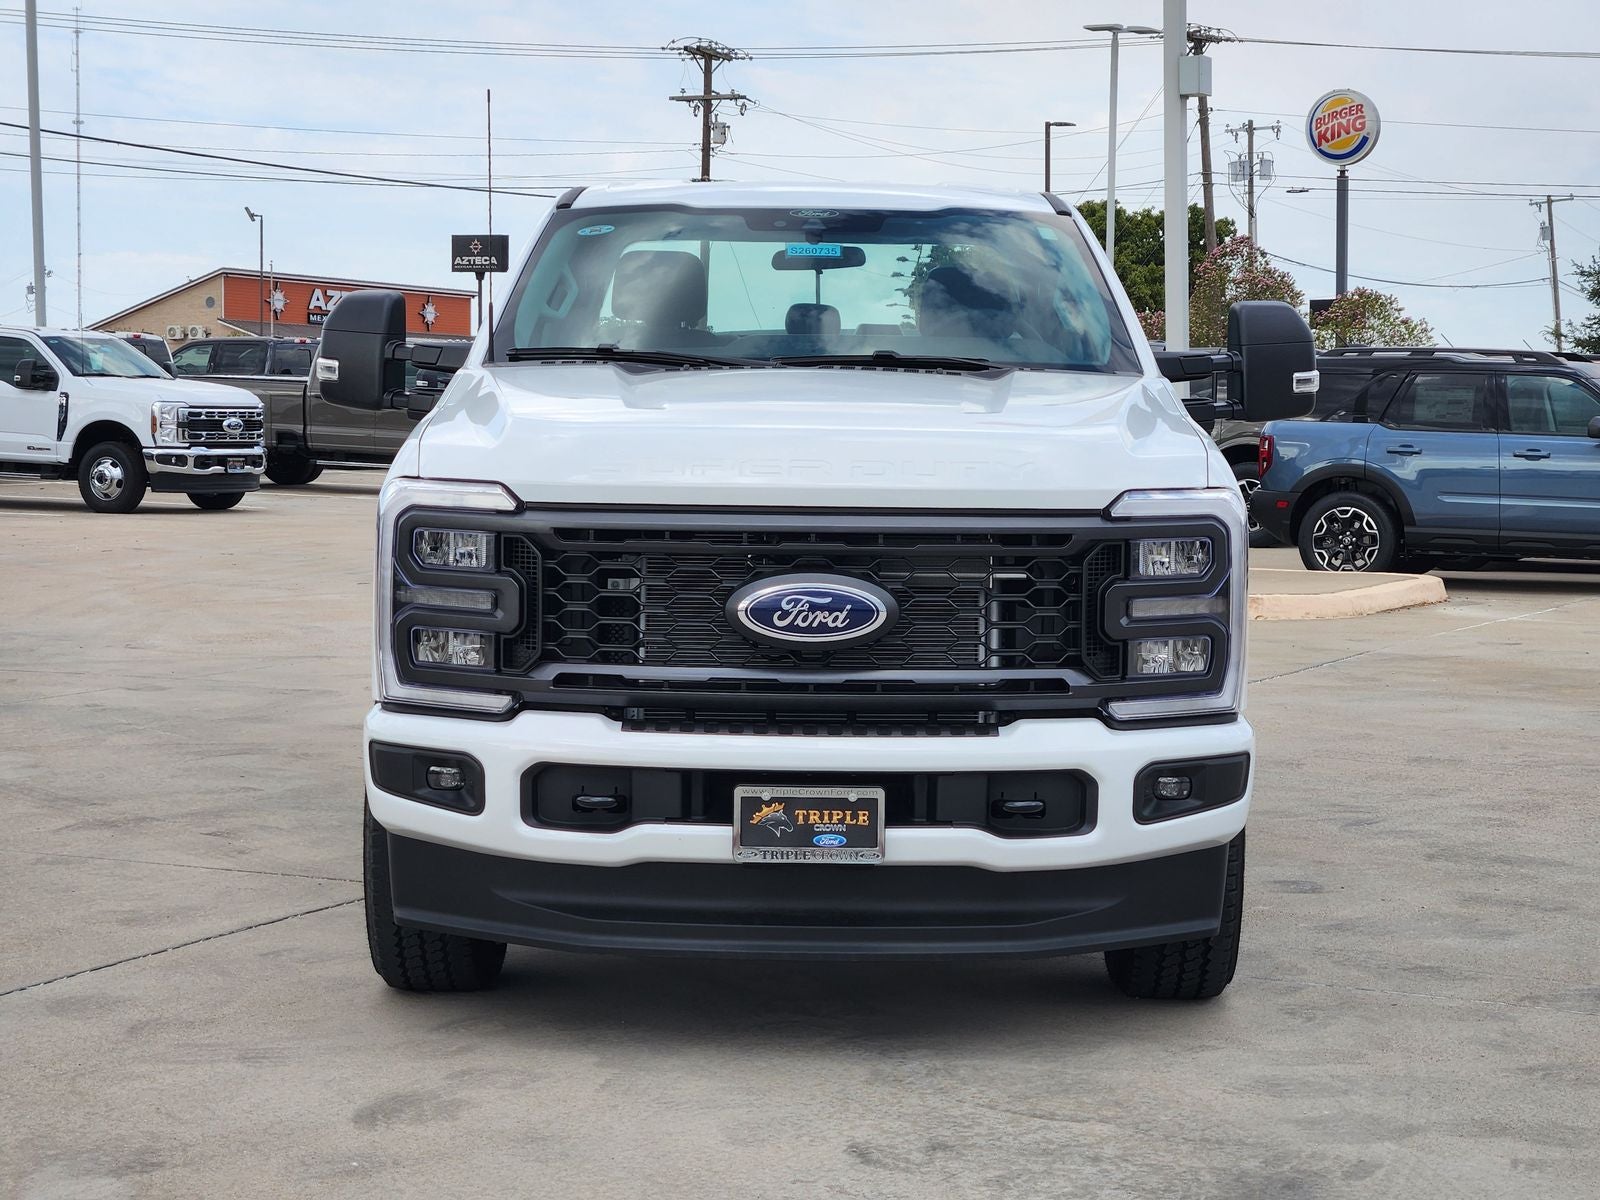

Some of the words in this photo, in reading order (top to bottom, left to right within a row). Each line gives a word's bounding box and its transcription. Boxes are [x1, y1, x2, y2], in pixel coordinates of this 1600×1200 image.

[1315, 103, 1364, 131] BURGER
[1316, 115, 1367, 148] KING
[790, 247, 838, 255] S260735
[454, 256, 498, 265] AZTECA
[773, 595, 852, 628] Ford
[795, 810, 869, 826] TRIPLE
[814, 824, 847, 832] CROWN
[819, 835, 840, 845] Ford
[761, 850, 811, 860] TRIPLE
[813, 850, 860, 861] CROWN
